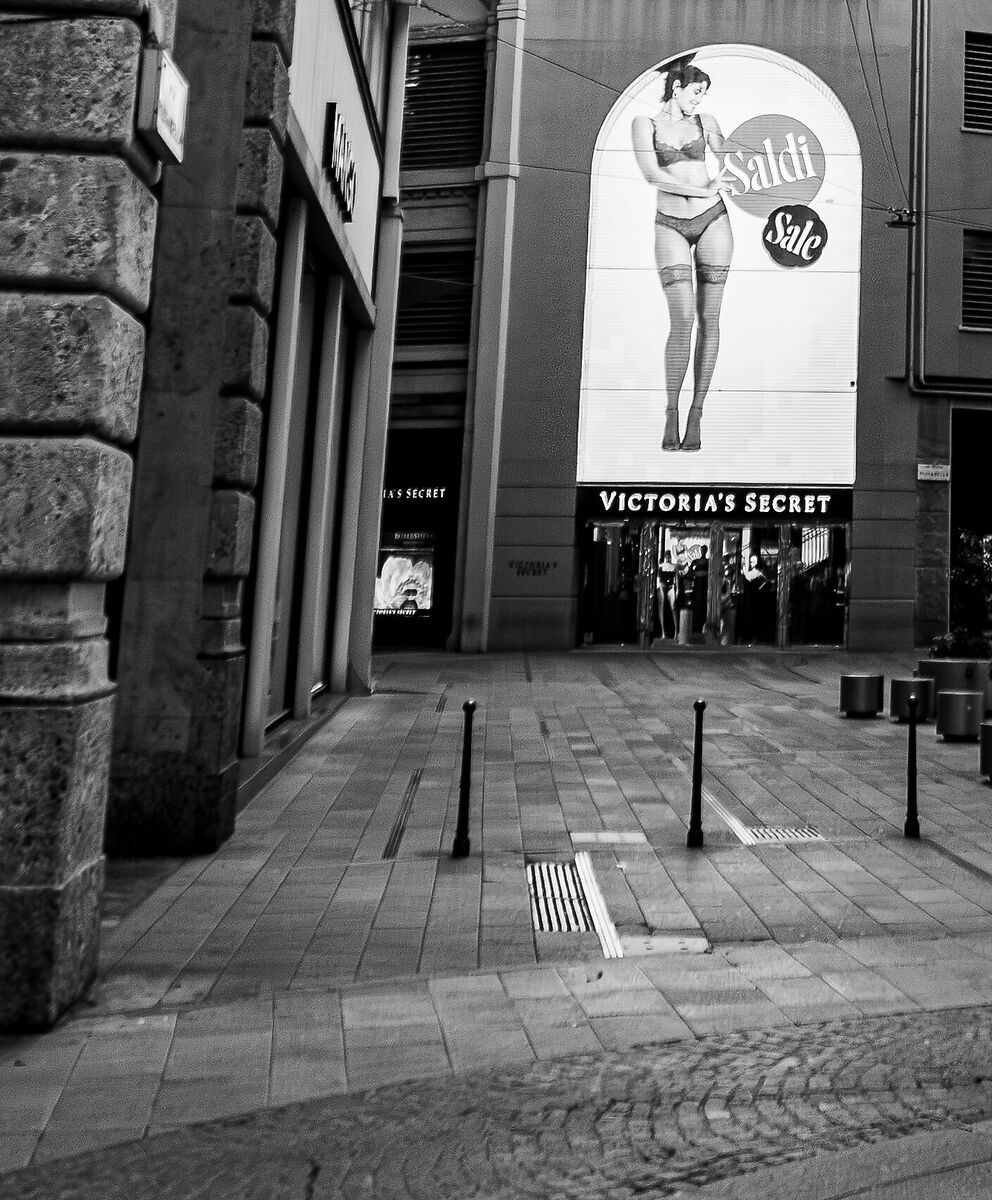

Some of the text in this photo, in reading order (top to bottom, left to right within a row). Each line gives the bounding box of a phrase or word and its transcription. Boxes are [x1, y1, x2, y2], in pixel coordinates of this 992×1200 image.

[722, 132, 818, 197] Saldi
[765, 211, 822, 261] Sale
[405, 487, 447, 499] SECRET
[599, 489, 832, 515] VICTORIA'S SECRET
